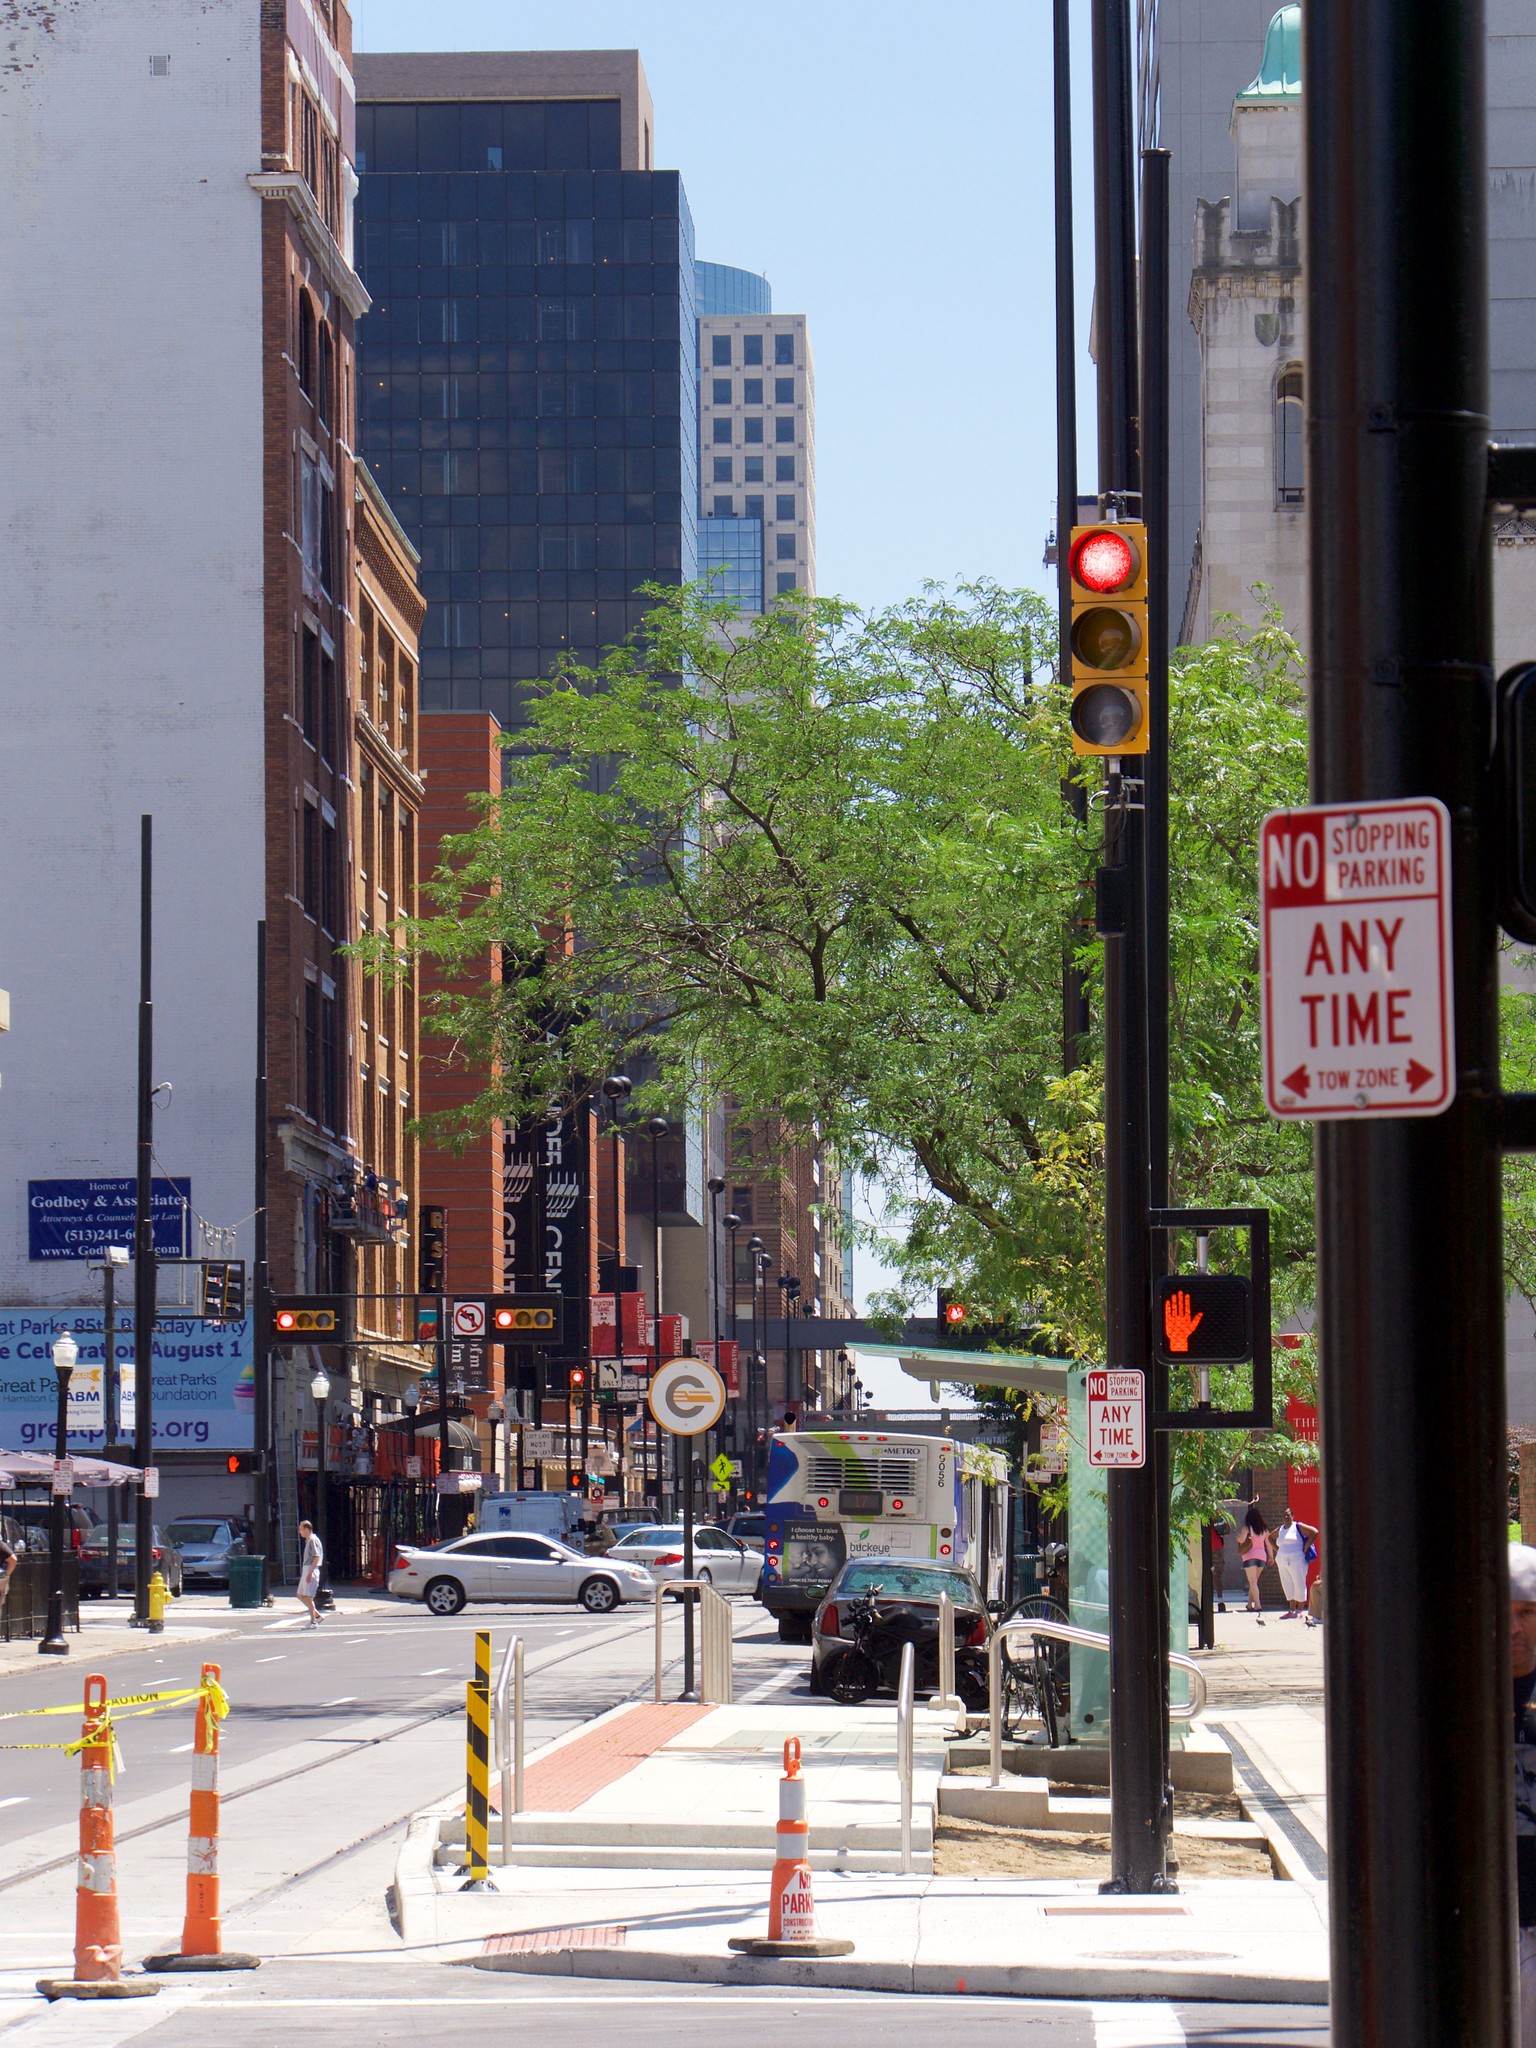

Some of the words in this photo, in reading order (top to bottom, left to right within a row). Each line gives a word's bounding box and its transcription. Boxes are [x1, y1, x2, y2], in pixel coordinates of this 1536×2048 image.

[1332, 821, 1430, 855] STOPPING
[1268, 832, 1319, 888] NO
[1338, 856, 1425, 889] PARKING
[1305, 917, 1404, 976] ANY
[1301, 989, 1412, 1048] TIME
[1317, 1071, 1350, 1090] TOW
[1356, 1068, 1399, 1088] ZONE
[89, 1182, 117, 1191] Home
[119, 1181, 130, 1190] of
[31, 1195, 89, 1210] Godbey
[94, 1195, 107, 1207] &
[40, 1215, 83, 1224] Attorneys
[85, 1214, 93, 1222] &
[152, 1213, 159, 1221] at
[161, 1212, 181, 1221] Law
[431, 1211, 444, 1228] R
[431, 1241, 443, 1258] S
[21, 1318, 68, 1335] Parks
[75, 1318, 104, 1332] 85t
[201, 1319, 248, 1337] Party
[152, 1340, 224, 1362] August
[231, 1340, 242, 1357] 1
[152, 1375, 178, 1386] reat
[181, 1373, 217, 1386] Parks
[1090, 1378, 1106, 1395] NO
[1109, 1376, 1139, 1385] STOPPING
[67, 1391, 100, 1401] ABM
[151, 1389, 217, 1401] oundation
[1111, 1387, 1137, 1396] PARKING
[1101, 1405, 1131, 1423] ANY
[1293, 1417, 1318, 1428] THE
[1100, 1428, 1133, 1445] TIME
[887, 1447, 921, 1455] METRO
[1293, 1468, 1308, 1476] and
[849, 1541, 890, 1554] buckeye
[799, 1871, 811, 1889] NO
